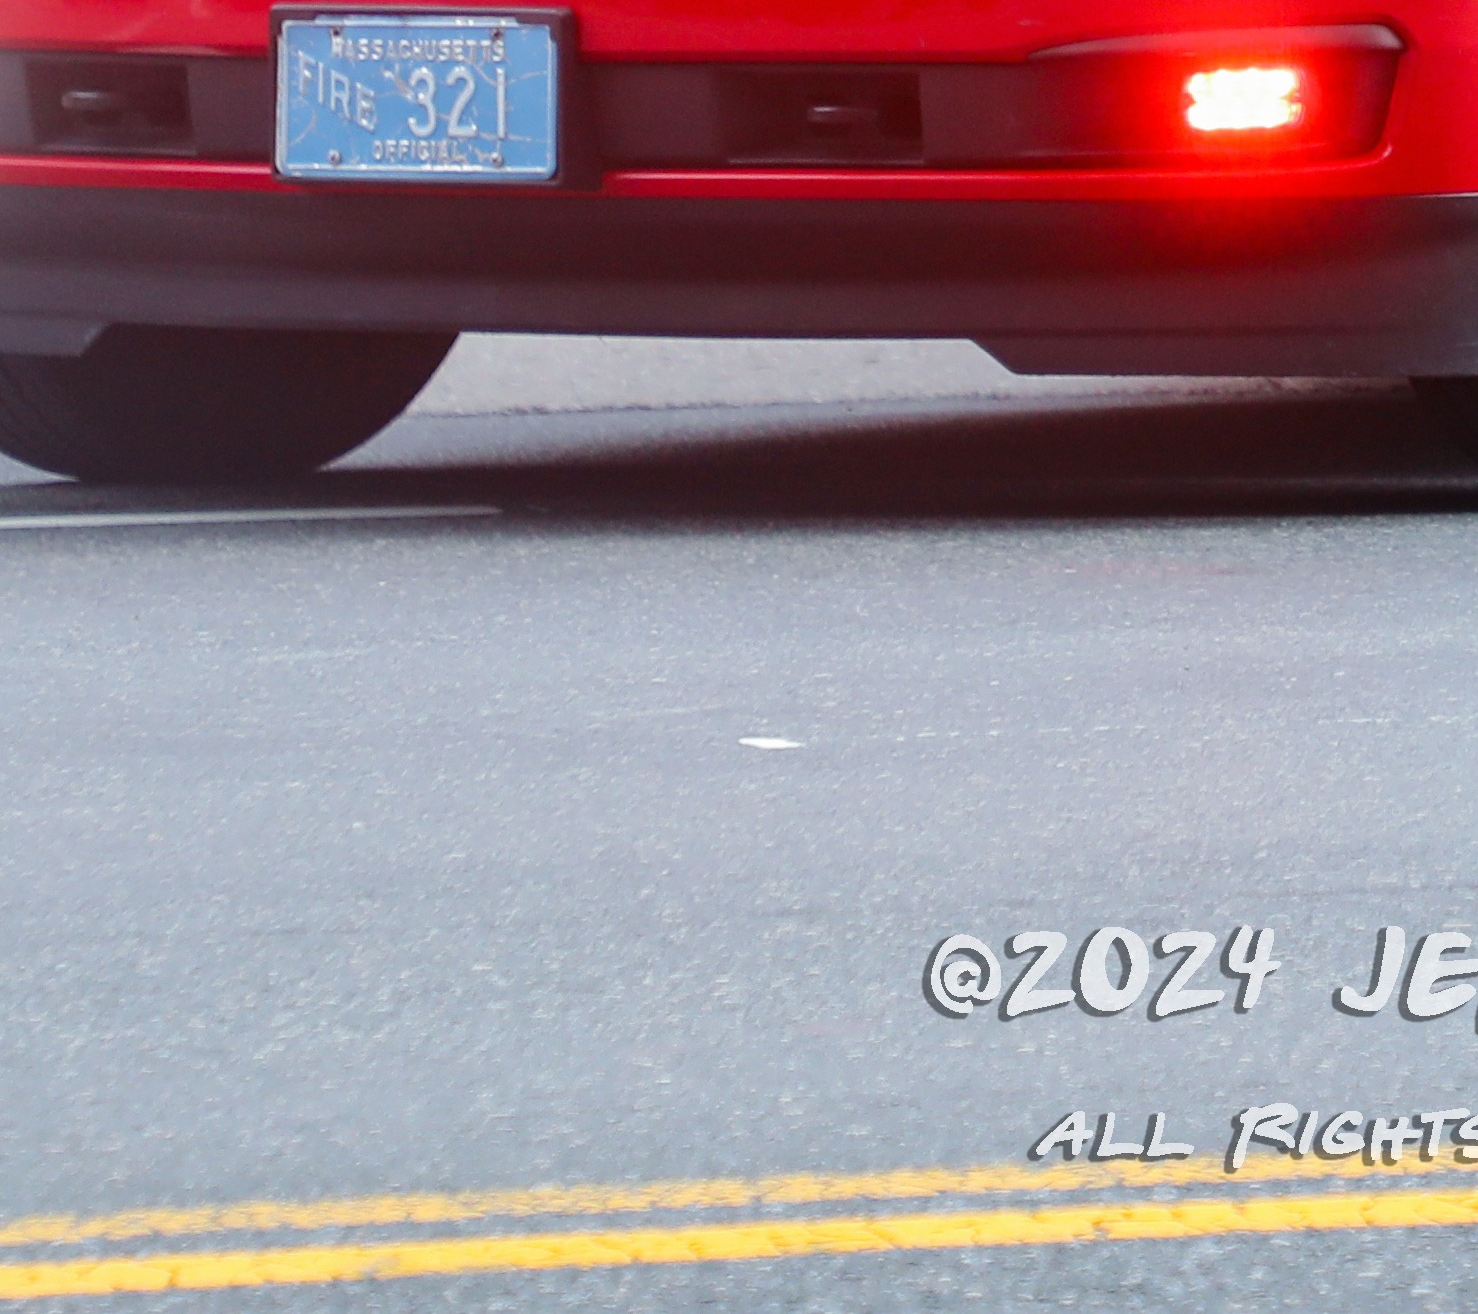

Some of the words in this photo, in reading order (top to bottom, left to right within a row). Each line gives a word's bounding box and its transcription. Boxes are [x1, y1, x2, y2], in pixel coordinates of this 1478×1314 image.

[330, 37, 504, 63] MASSACHUSETTS
[297, 50, 375, 133] FIRE
[408, 66, 507, 139] 321
[372, 139, 467, 163] OFFICIAL
